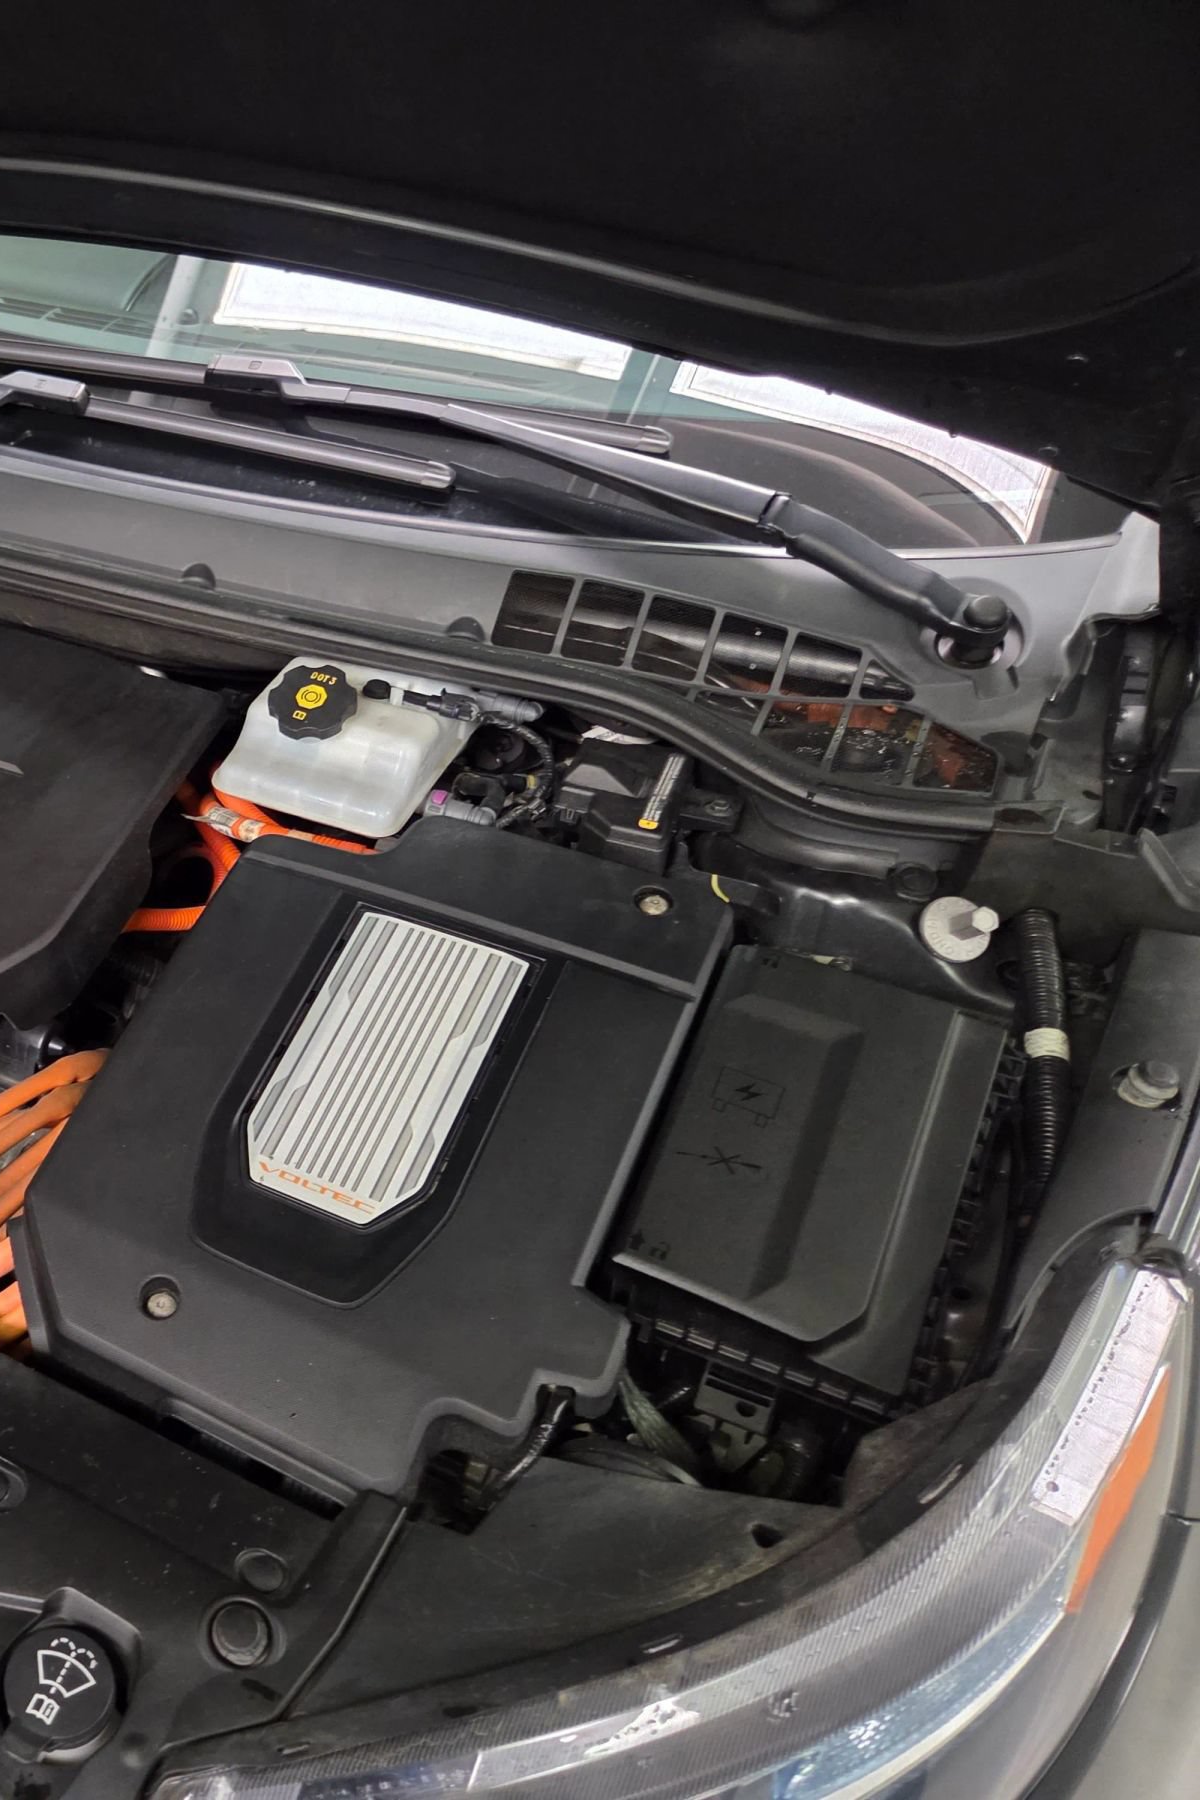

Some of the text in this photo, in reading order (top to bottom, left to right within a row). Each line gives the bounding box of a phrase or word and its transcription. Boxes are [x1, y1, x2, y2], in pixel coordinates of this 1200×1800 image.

[310, 671, 337, 685] DOT 3
[259, 1161, 376, 1215] VOLTEC
